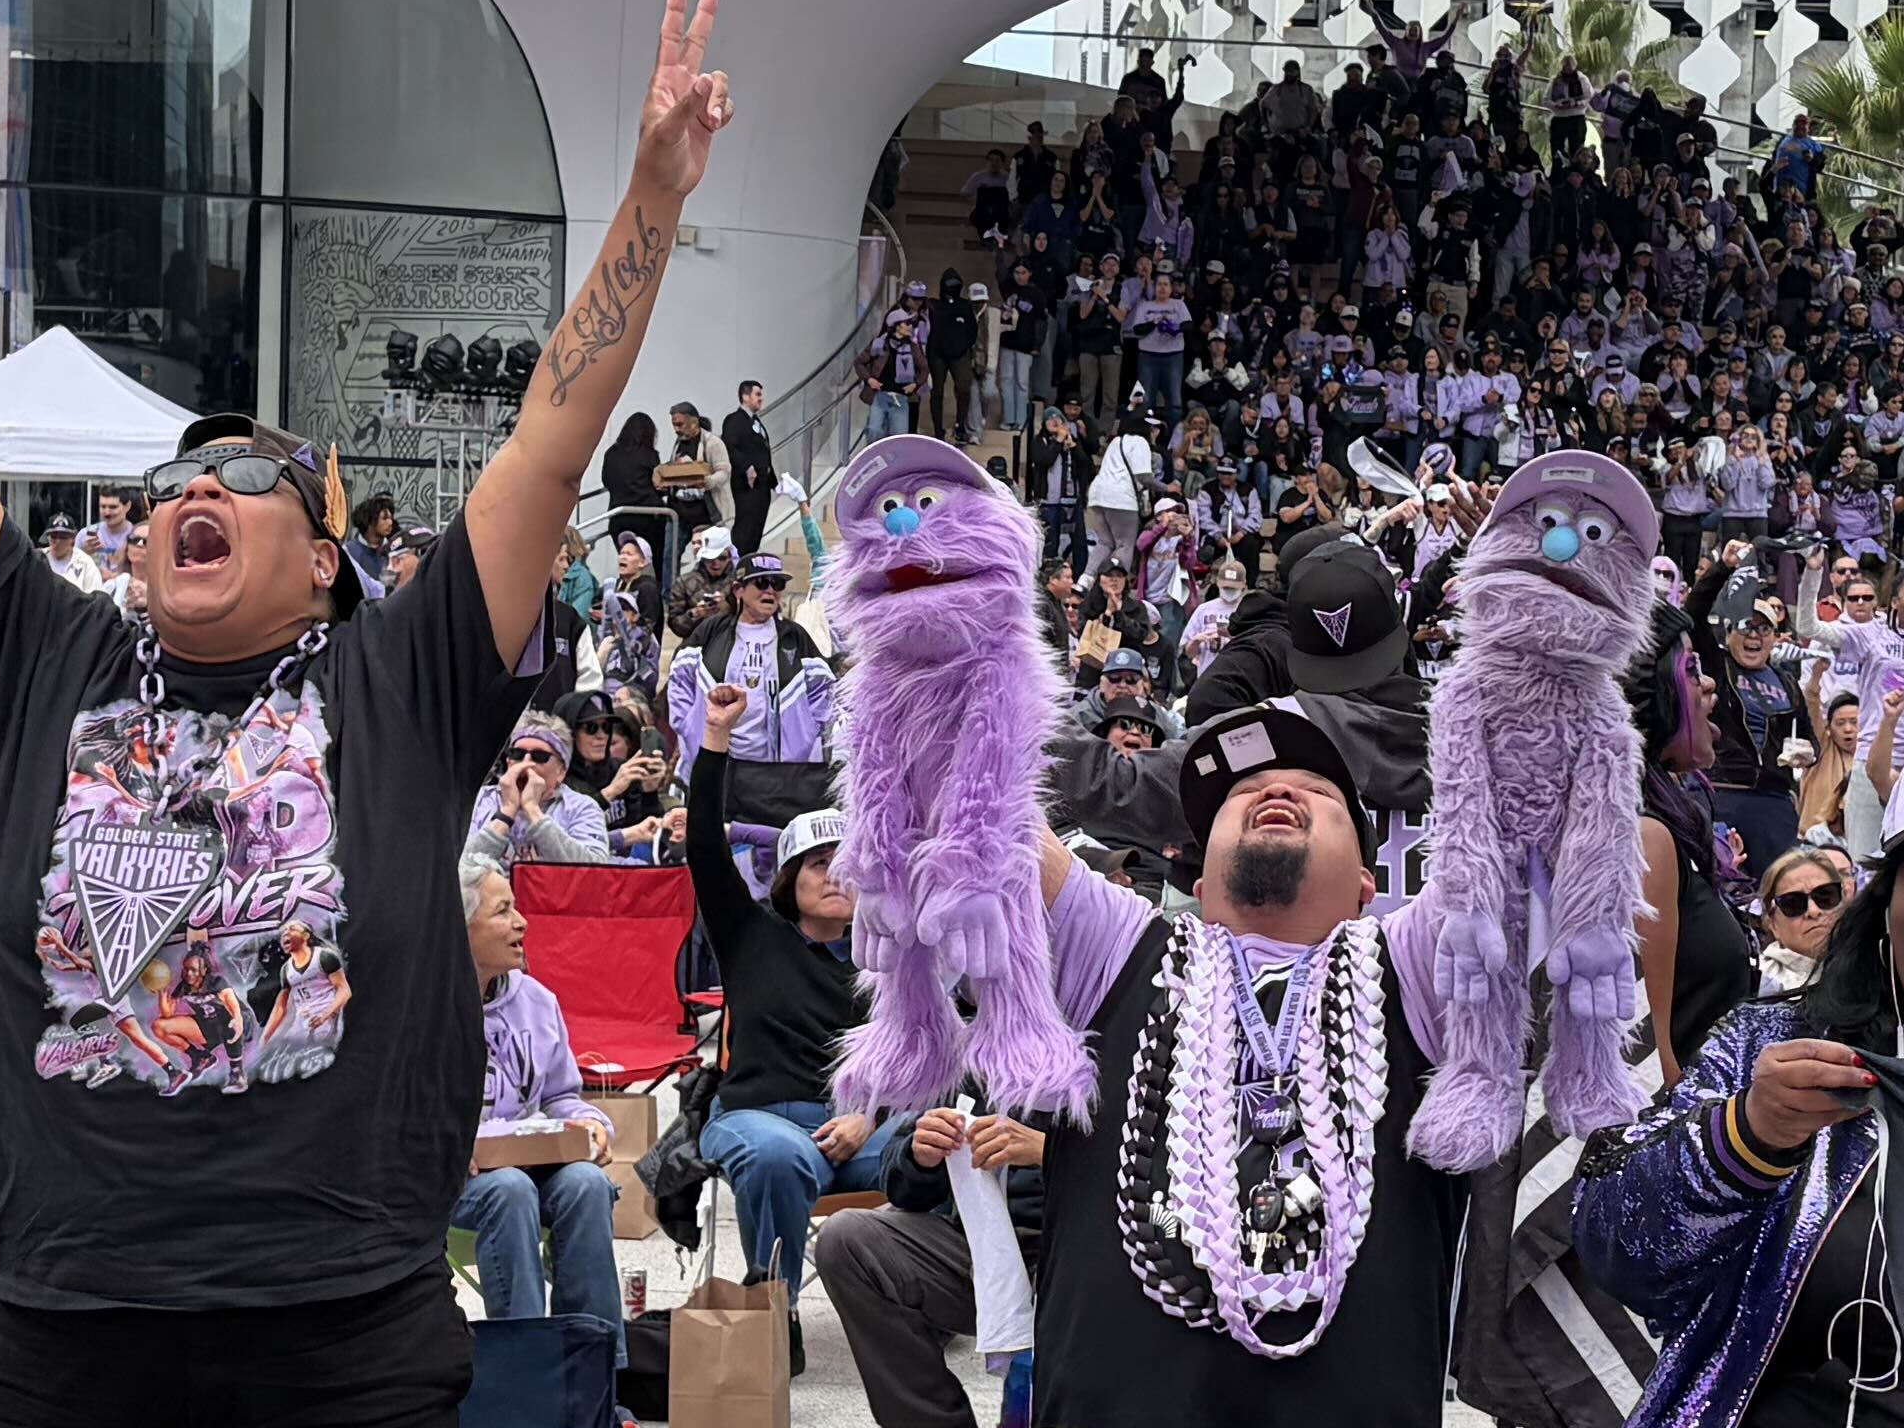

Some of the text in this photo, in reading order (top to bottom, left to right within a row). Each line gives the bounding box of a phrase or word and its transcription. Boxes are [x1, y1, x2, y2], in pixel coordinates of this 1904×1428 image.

[457, 245, 489, 262] NBA
[374, 263, 459, 283] GOLDEN
[372, 283, 540, 310] WARRIORS
[95, 825, 202, 849] GOLDEN STATE
[72, 840, 215, 890] VALKYRIES
